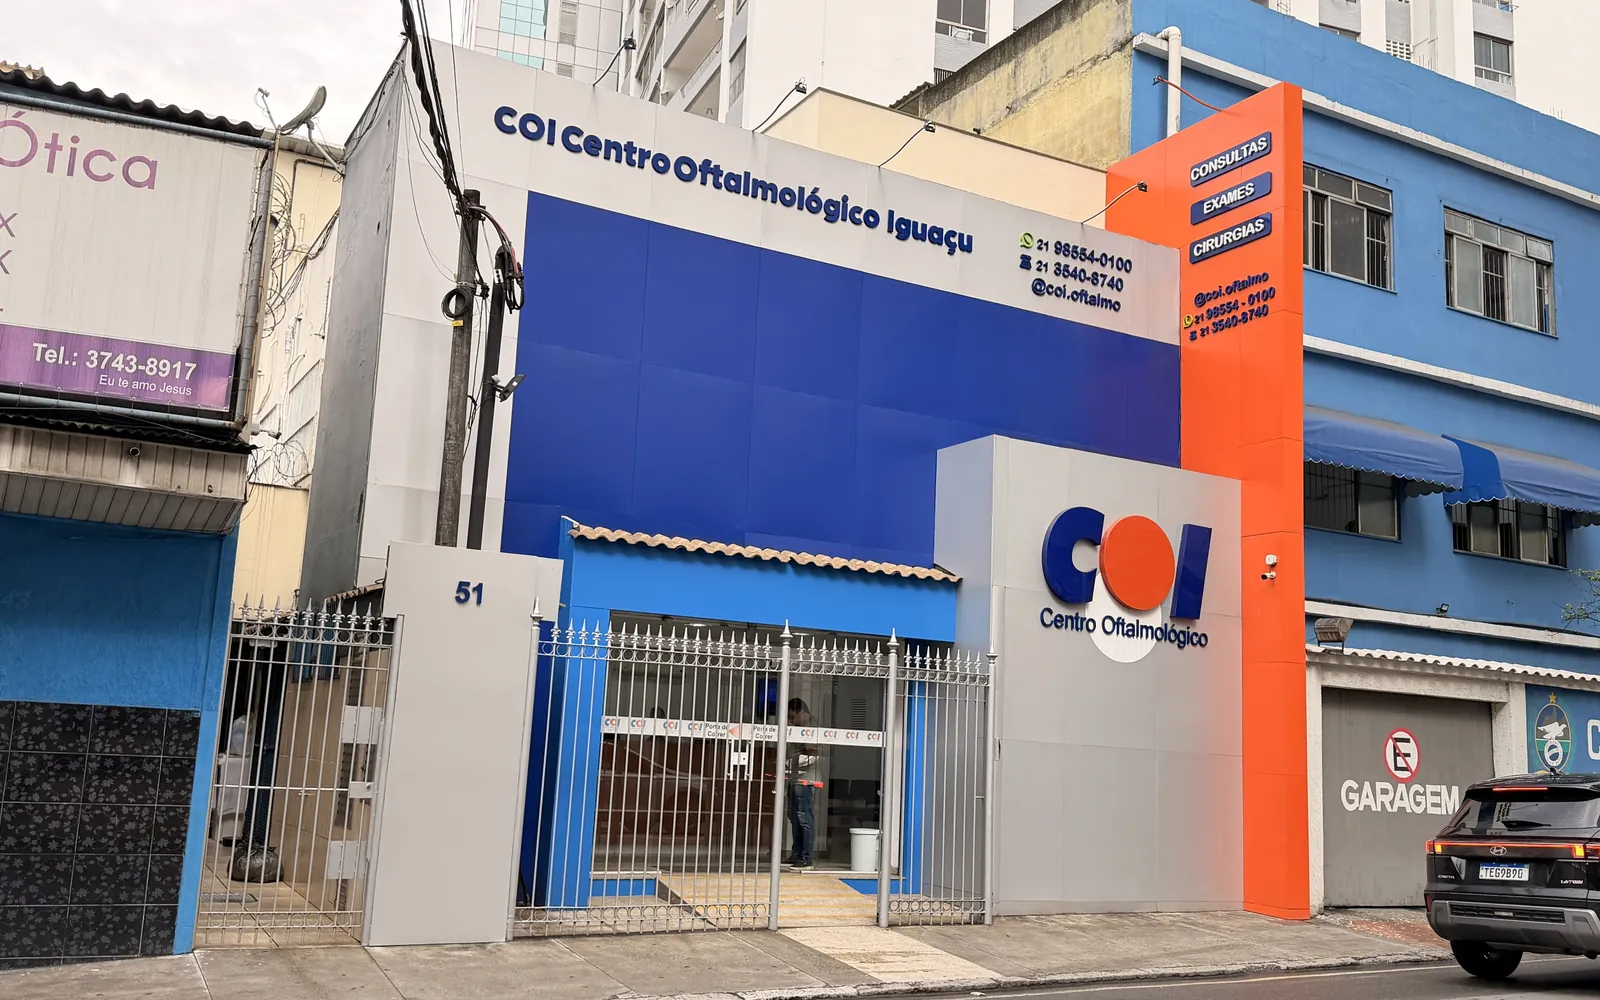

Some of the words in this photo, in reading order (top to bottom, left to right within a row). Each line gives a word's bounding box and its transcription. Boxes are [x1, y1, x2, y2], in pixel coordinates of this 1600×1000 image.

[0, 111, 158, 190] Ótica
[1190, 136, 1268, 181] CONSULTAS
[494, 105, 557, 146] COI
[561, 125, 671, 174] Centro
[674, 155, 880, 229] Oftalmológico
[887, 209, 973, 255] Iguaçu
[1203, 182, 1255, 214] EXAMES
[1193, 218, 1265, 257] CIRURGIAS
[1036, 239, 1049, 252] 21
[1054, 240, 1132, 273] 98554-0100
[1035, 260, 1048, 273] 21
[1053, 262, 1124, 292] 3540-8740
[1194, 272, 1269, 308] @coi.oftalmo
[1031, 278, 1121, 312] @coi.oftalmo
[1194, 313, 1204, 324] 21
[1206, 299, 1239, 320] 98554
[1248, 286, 1276, 306] 0100
[1200, 326, 1209, 337] 21
[1211, 304, 1269, 333] 3540-8740
[32, 342, 78, 366] Tel.:
[85, 349, 197, 381] 3743-8917
[99, 373, 116, 387] Eu
[118, 376, 130, 388] te
[132, 379, 157, 392] amo
[159, 381, 192, 396] Jesus
[1041, 506, 1213, 621] COI
[454, 580, 484, 607] 51
[1040, 607, 1096, 633] Centro
[1101, 615, 1208, 649] Oftalmológico
[705, 722, 721, 731] Pora
[1340, 779, 1460, 815] GARAGEM
